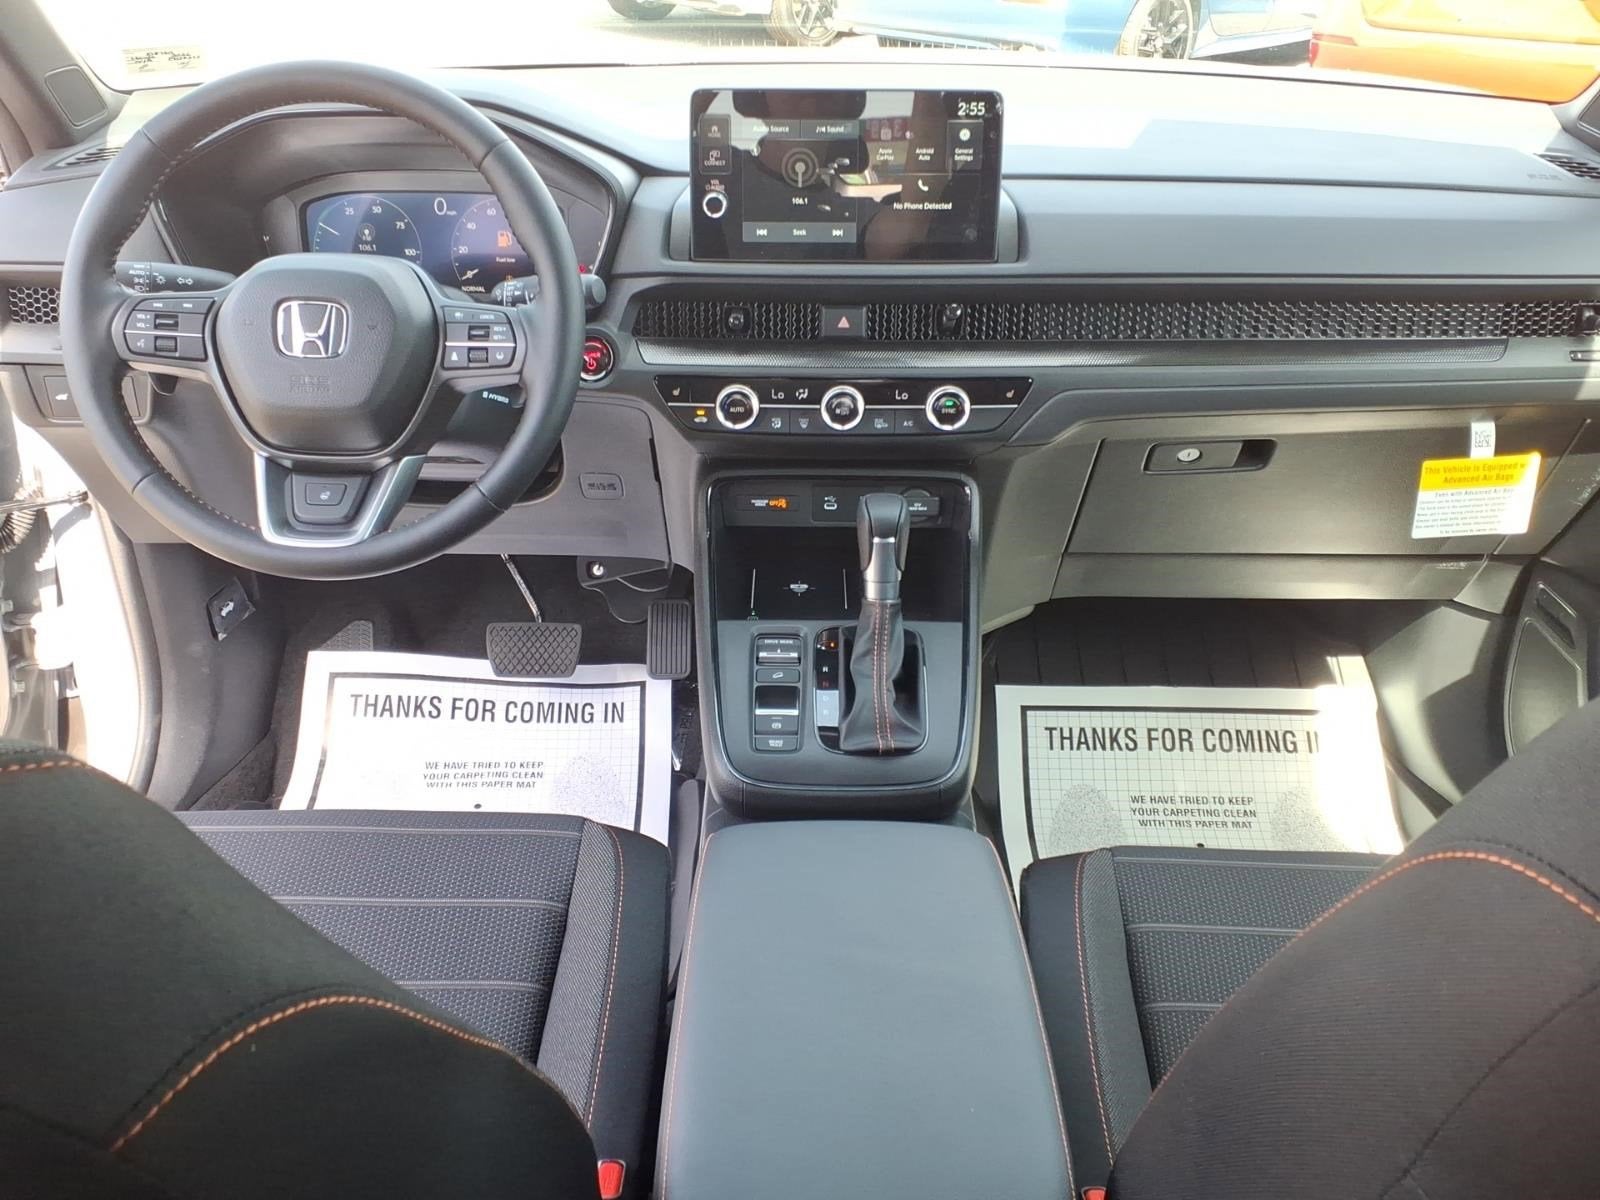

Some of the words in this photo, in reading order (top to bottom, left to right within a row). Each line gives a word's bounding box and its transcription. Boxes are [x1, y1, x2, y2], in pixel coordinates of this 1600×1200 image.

[957, 102, 985, 116] 2:55
[434, 197, 447, 215] 0
[893, 202, 903, 210] No
[903, 202, 923, 210] Phone
[924, 202, 952, 210] Detected
[486, 208, 497, 216] 60
[395, 221, 406, 230] 75
[466, 223, 476, 231] 40
[358, 244, 377, 252] 106.1
[404, 248, 417, 256] 100
[458, 246, 468, 254] 20
[771, 388, 785, 400] Lo
[895, 389, 909, 401] Lo
[729, 406, 745, 414] AUTO
[1424, 466, 1441, 475] This
[1443, 464, 1472, 474] Vehicle
[1483, 462, 1518, 473] Equipped
[1442, 475, 1481, 484] Advanced
[1484, 474, 1493, 482] Air
[1495, 473, 1515, 482] Bags
[350, 694, 442, 719] THANKS
[451, 697, 497, 723] FOR
[504, 700, 596, 724] COMING
[603, 701, 625, 723] IN
[1044, 726, 1139, 752] THANKS
[1147, 727, 1194, 752] FOR
[1202, 728, 1299, 754] COMING
[425, 761, 441, 770] WE
[443, 761, 469, 770] HAVE
[472, 761, 501, 769] TRIED
[505, 761, 516, 769] TO
[519, 761, 544, 769] KEEP
[423, 772, 450, 781] YOUR
[453, 771, 509, 780] CARPETING
[511, 771, 544, 779] CLEAN
[516, 781, 536, 789] MAT
[1130, 795, 1147, 804] WE
[1149, 796, 1176, 805] HAVE
[1179, 796, 1209, 805] TRIED
[1212, 796, 1225, 805] TO
[1228, 797, 1254, 805] KEEP
[1130, 807, 1160, 816] YOUR
[1163, 808, 1221, 817] CARPETING
[1223, 809, 1257, 817] CLEAN
[1138, 819, 1166, 827] WITH
[1168, 819, 1192, 828] THIS
[1195, 820, 1229, 828] PAPER
[1231, 820, 1254, 829] MAT
